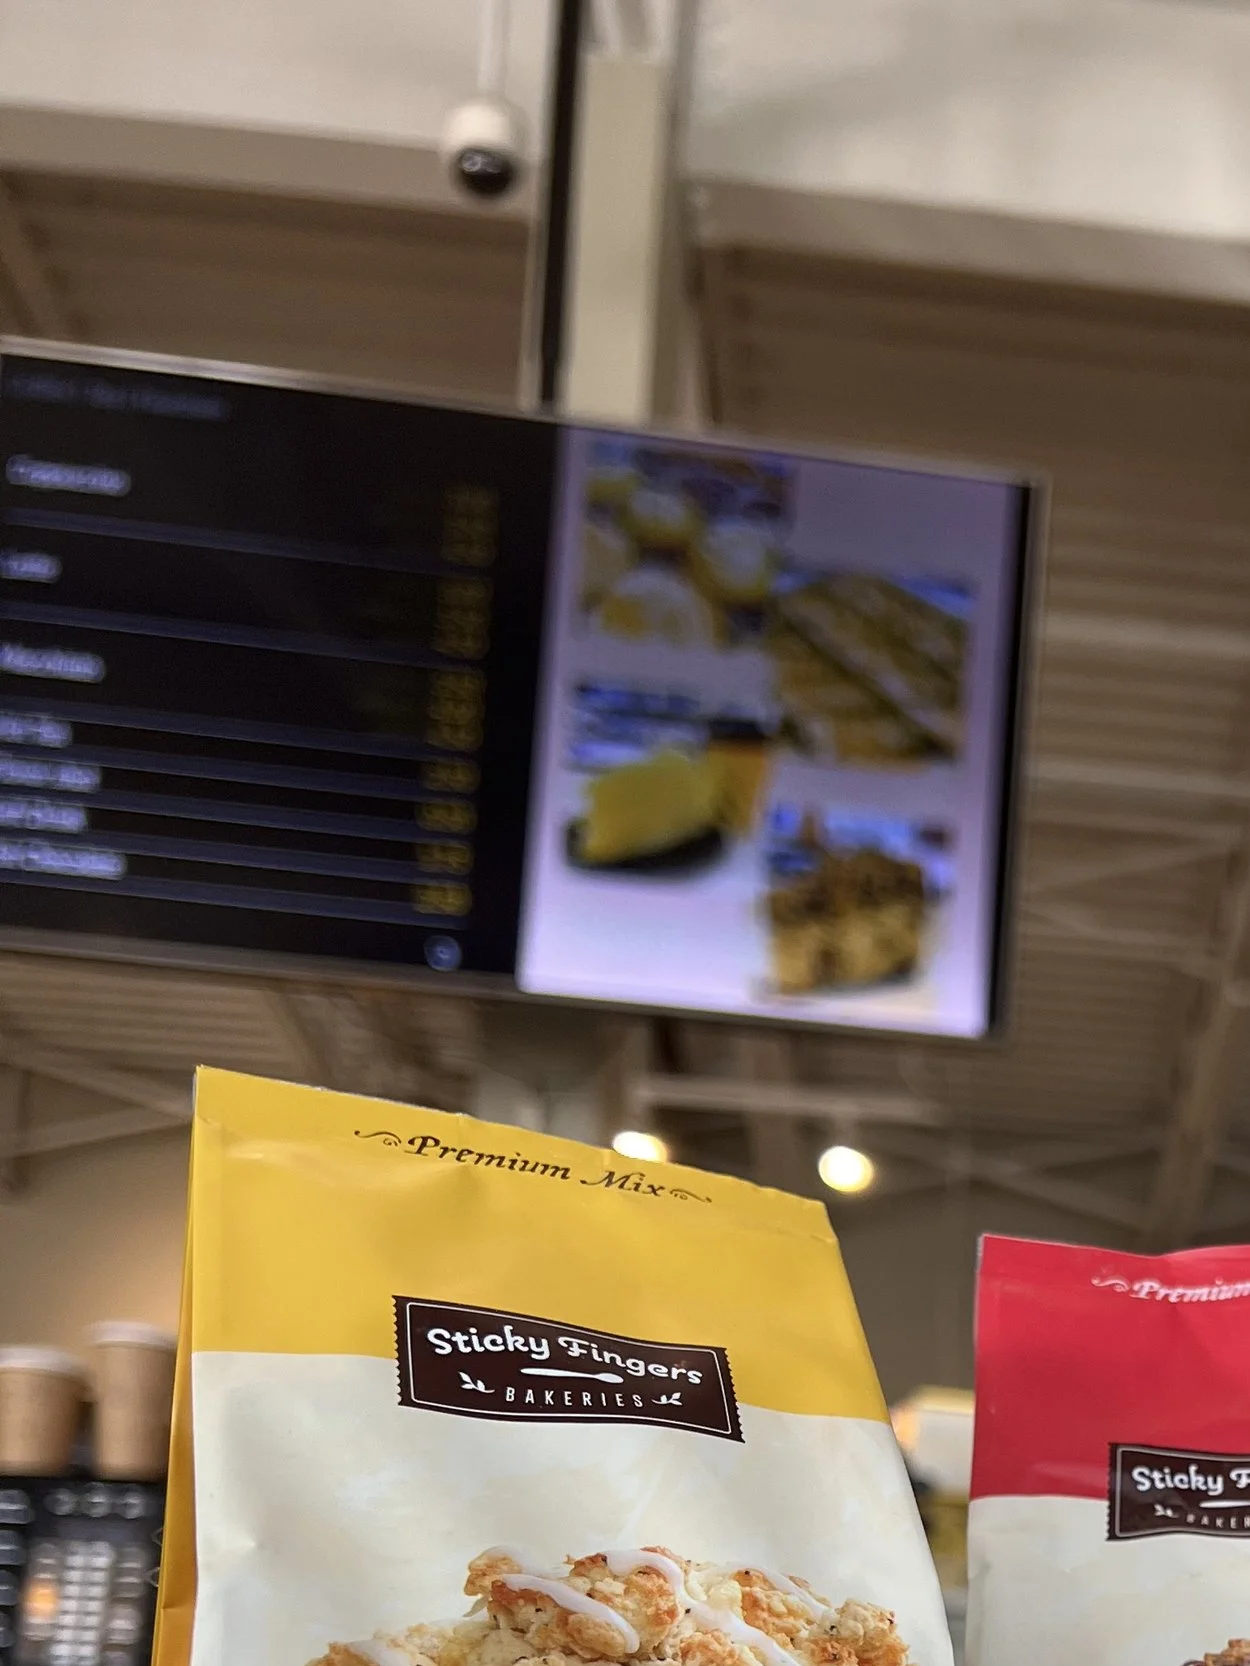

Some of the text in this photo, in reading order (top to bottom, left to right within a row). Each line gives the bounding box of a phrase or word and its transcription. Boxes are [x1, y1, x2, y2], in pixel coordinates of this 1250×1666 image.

[404, 1134, 666, 1198] Premium Mix
[427, 1324, 703, 1385] Sticky Fingers
[506, 1387, 643, 1407] BAKERIES
[1131, 1464, 1224, 1496] Sticky
